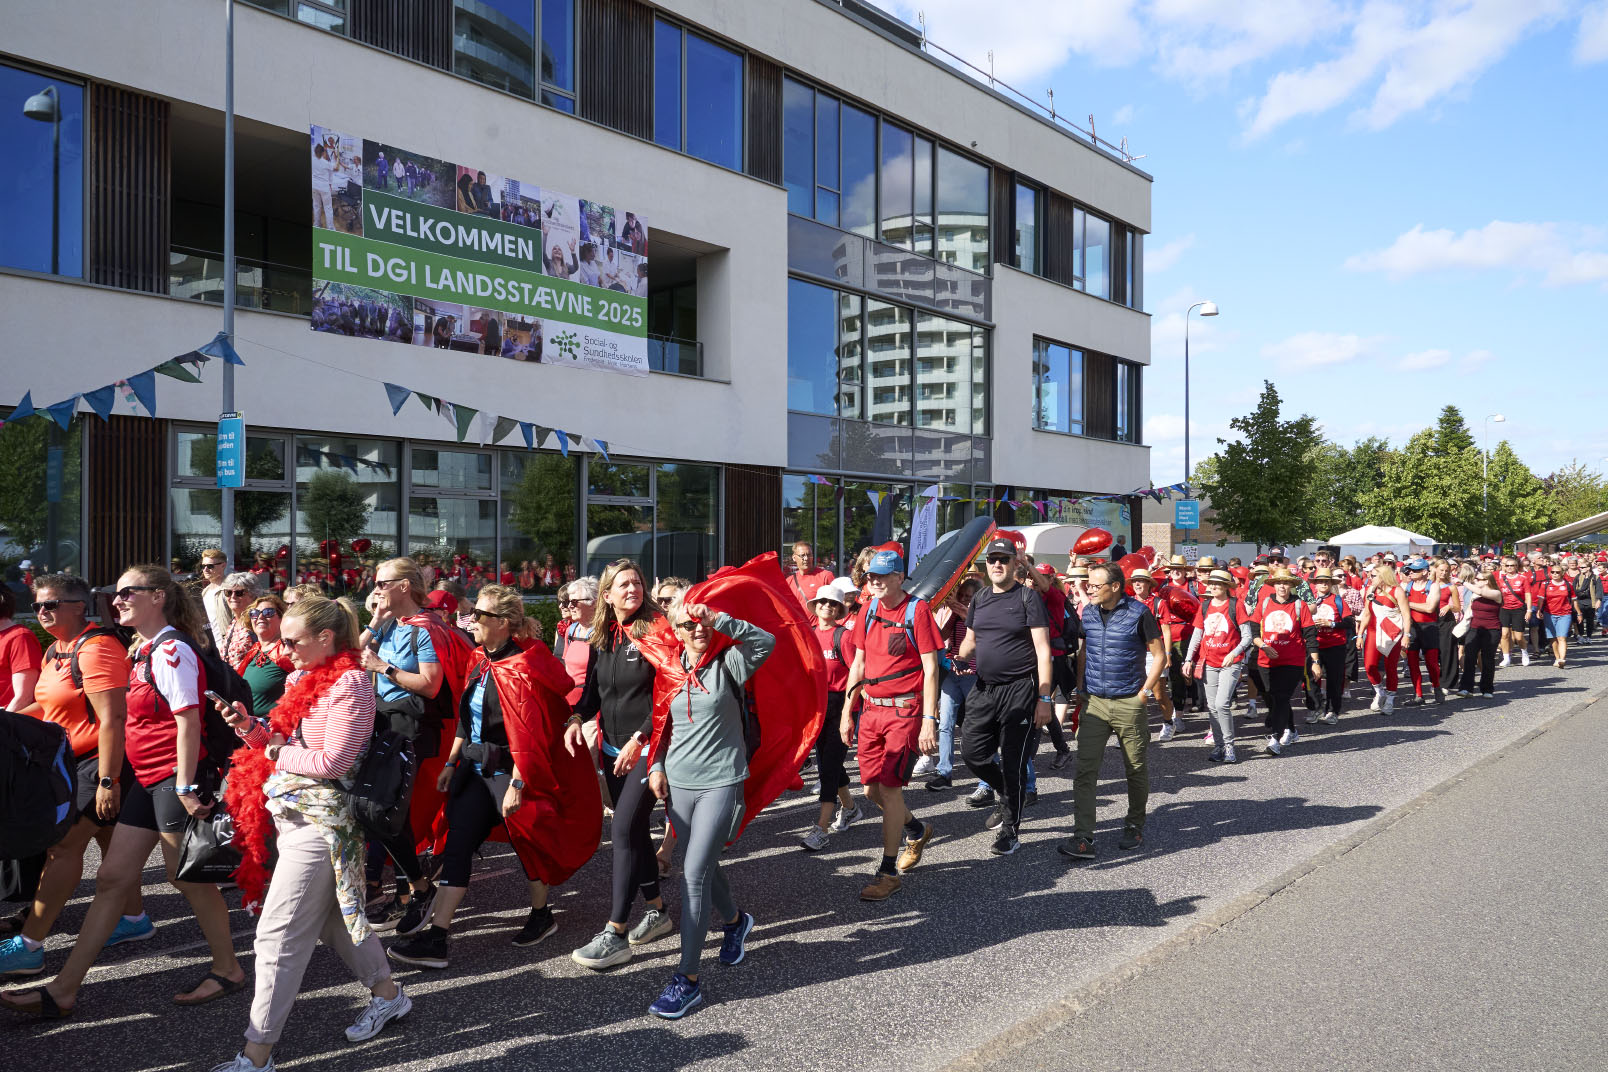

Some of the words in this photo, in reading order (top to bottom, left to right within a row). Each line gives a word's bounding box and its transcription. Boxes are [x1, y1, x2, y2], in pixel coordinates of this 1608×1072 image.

[369, 203, 534, 261] VELKOMMEN
[319, 242, 358, 273] TIL
[367, 252, 417, 285] DGI
[425, 264, 593, 318] LANDSSTÆVNE
[598, 300, 642, 328] 2025
[584, 335, 608, 347] Social-
[609, 342, 618, 352] og
[584, 346, 642, 363] Sundhedsskolen
